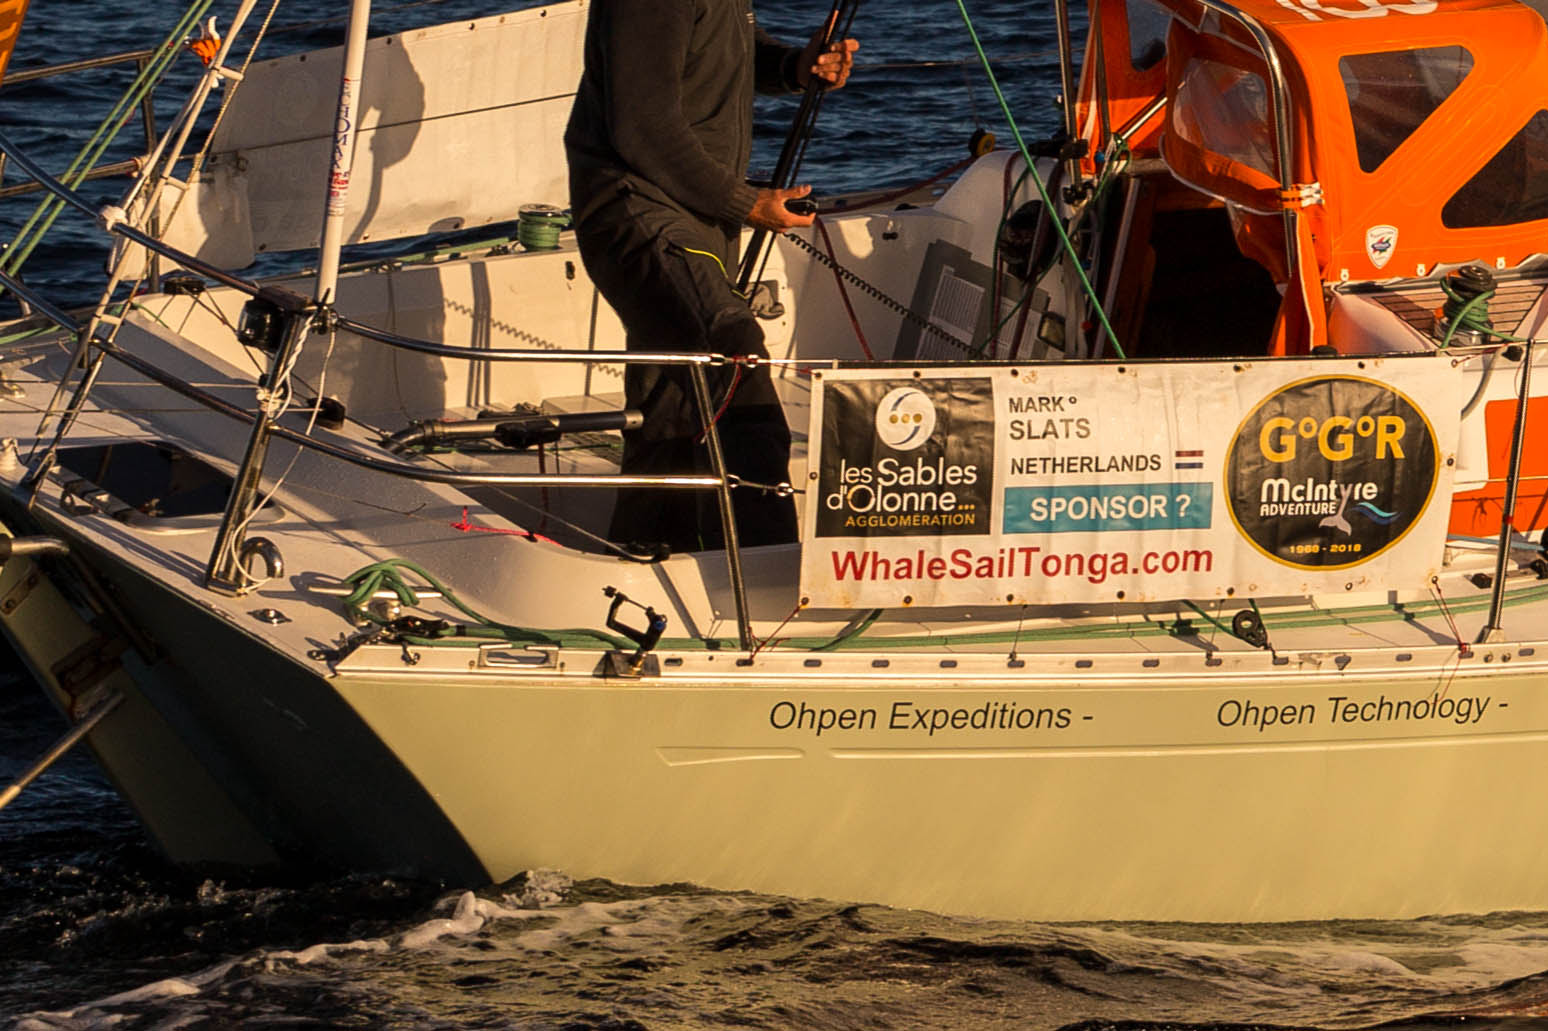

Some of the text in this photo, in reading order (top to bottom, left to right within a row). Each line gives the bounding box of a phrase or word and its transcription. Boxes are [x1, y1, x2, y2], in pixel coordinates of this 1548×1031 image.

[1009, 417, 1091, 441] SLATS
[840, 456, 977, 487] les Sables
[1010, 454, 1162, 476] NETHERLANDS
[1030, 494, 1192, 522] SPONSOR ?
[1260, 477, 1379, 514] McIntyre
[1260, 502, 1337, 517] ADVENTURE
[831, 546, 1213, 585] WhaleSailTonga.com
[769, 701, 877, 737] Ohpen
[888, 701, 1072, 737] Expeditions
[1217, 699, 1315, 732] Ohpen
[1328, 692, 1491, 725] Technology
